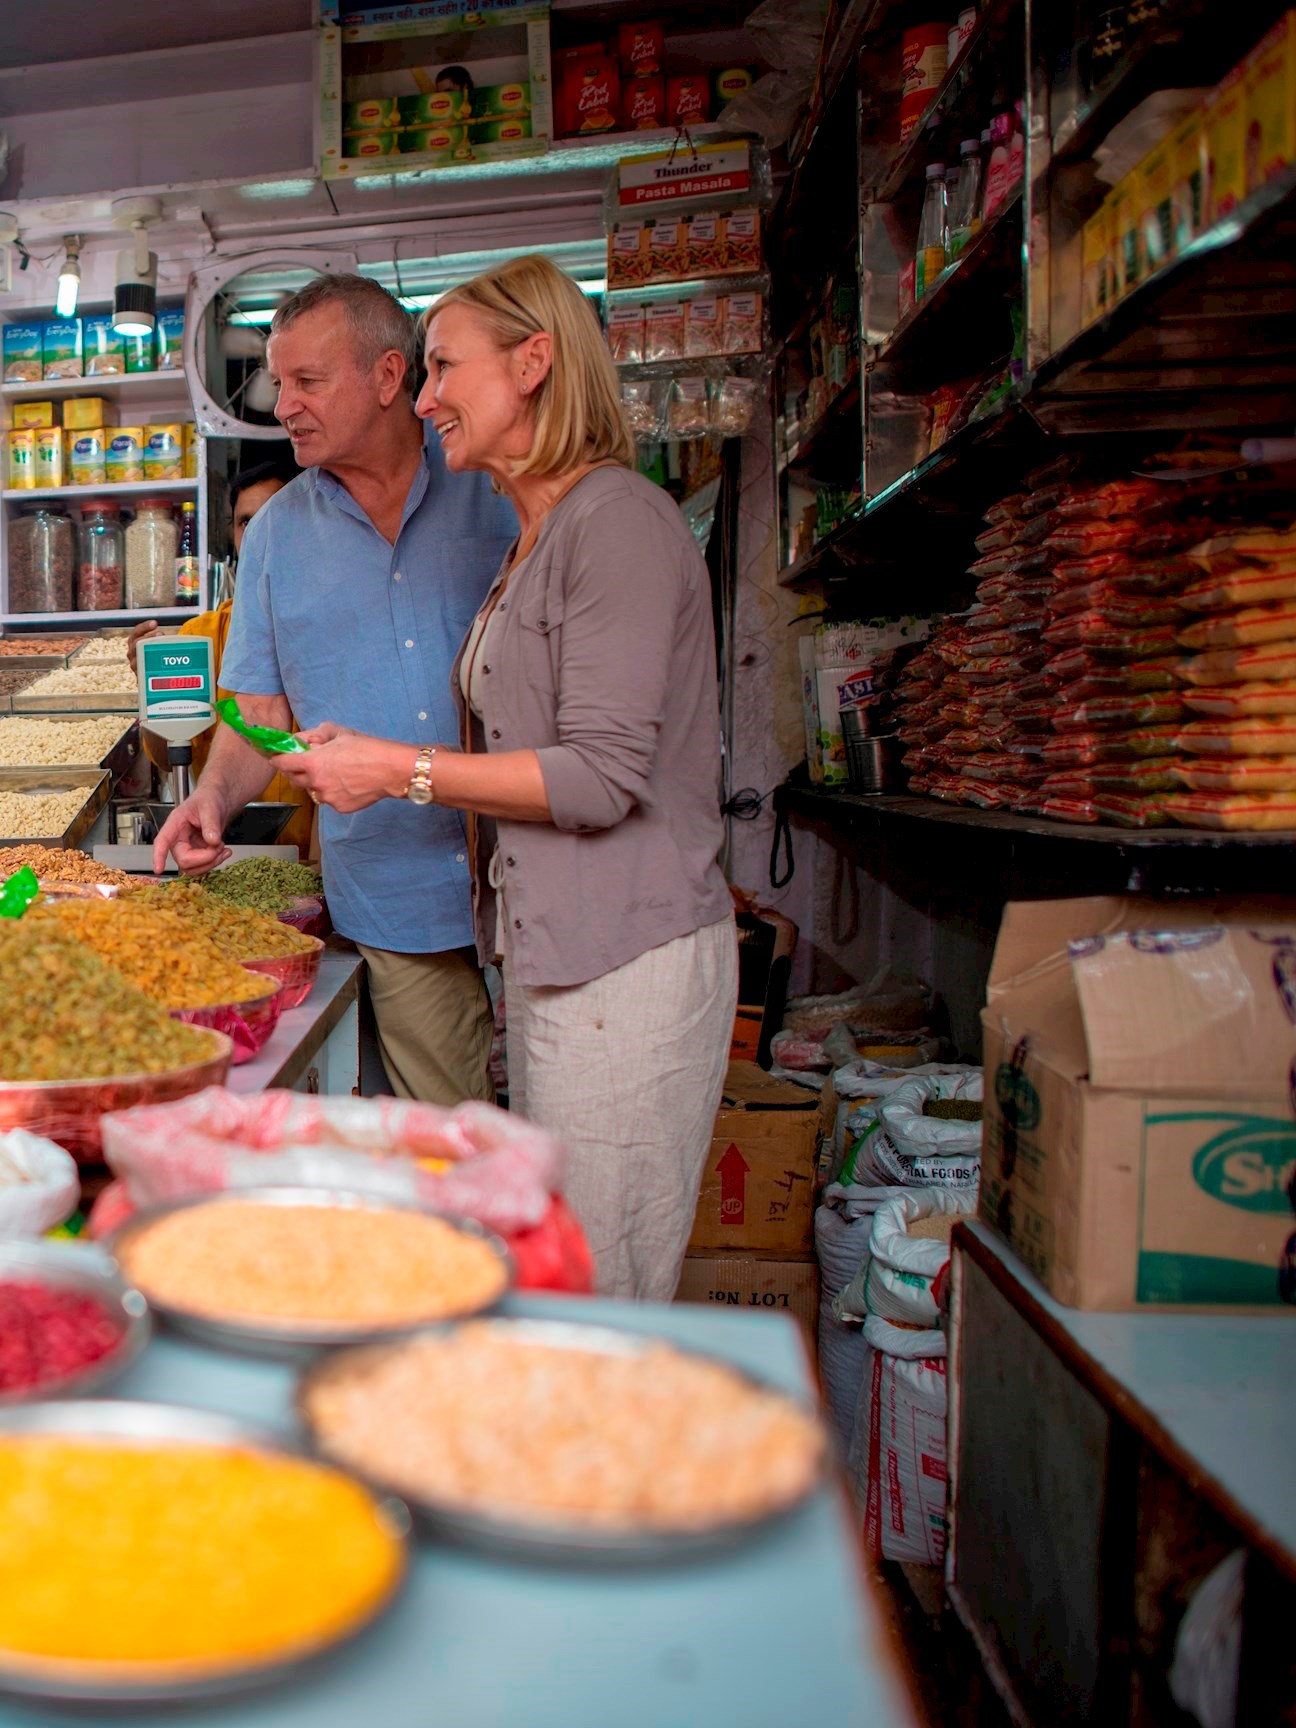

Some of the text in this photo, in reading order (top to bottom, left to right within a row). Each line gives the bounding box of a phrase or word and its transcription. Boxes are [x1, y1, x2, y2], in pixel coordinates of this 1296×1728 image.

[634, 38, 654, 51] Red
[631, 47, 656, 61] Label
[581, 83, 607, 98] Red
[578, 93, 609, 111] Label
[634, 96, 655, 108] Red
[679, 92, 700, 104] Red
[631, 105, 656, 119] Label
[676, 101, 702, 115] Label
[655, 163, 713, 178] Thunder
[636, 177, 732, 200] Pasta Masala
[163, 656, 190, 665] TOYO
[931, 1168, 970, 1179] FOODS
[724, 1200, 741, 1213] UP
[709, 1290, 789, 1307] LOT No:
